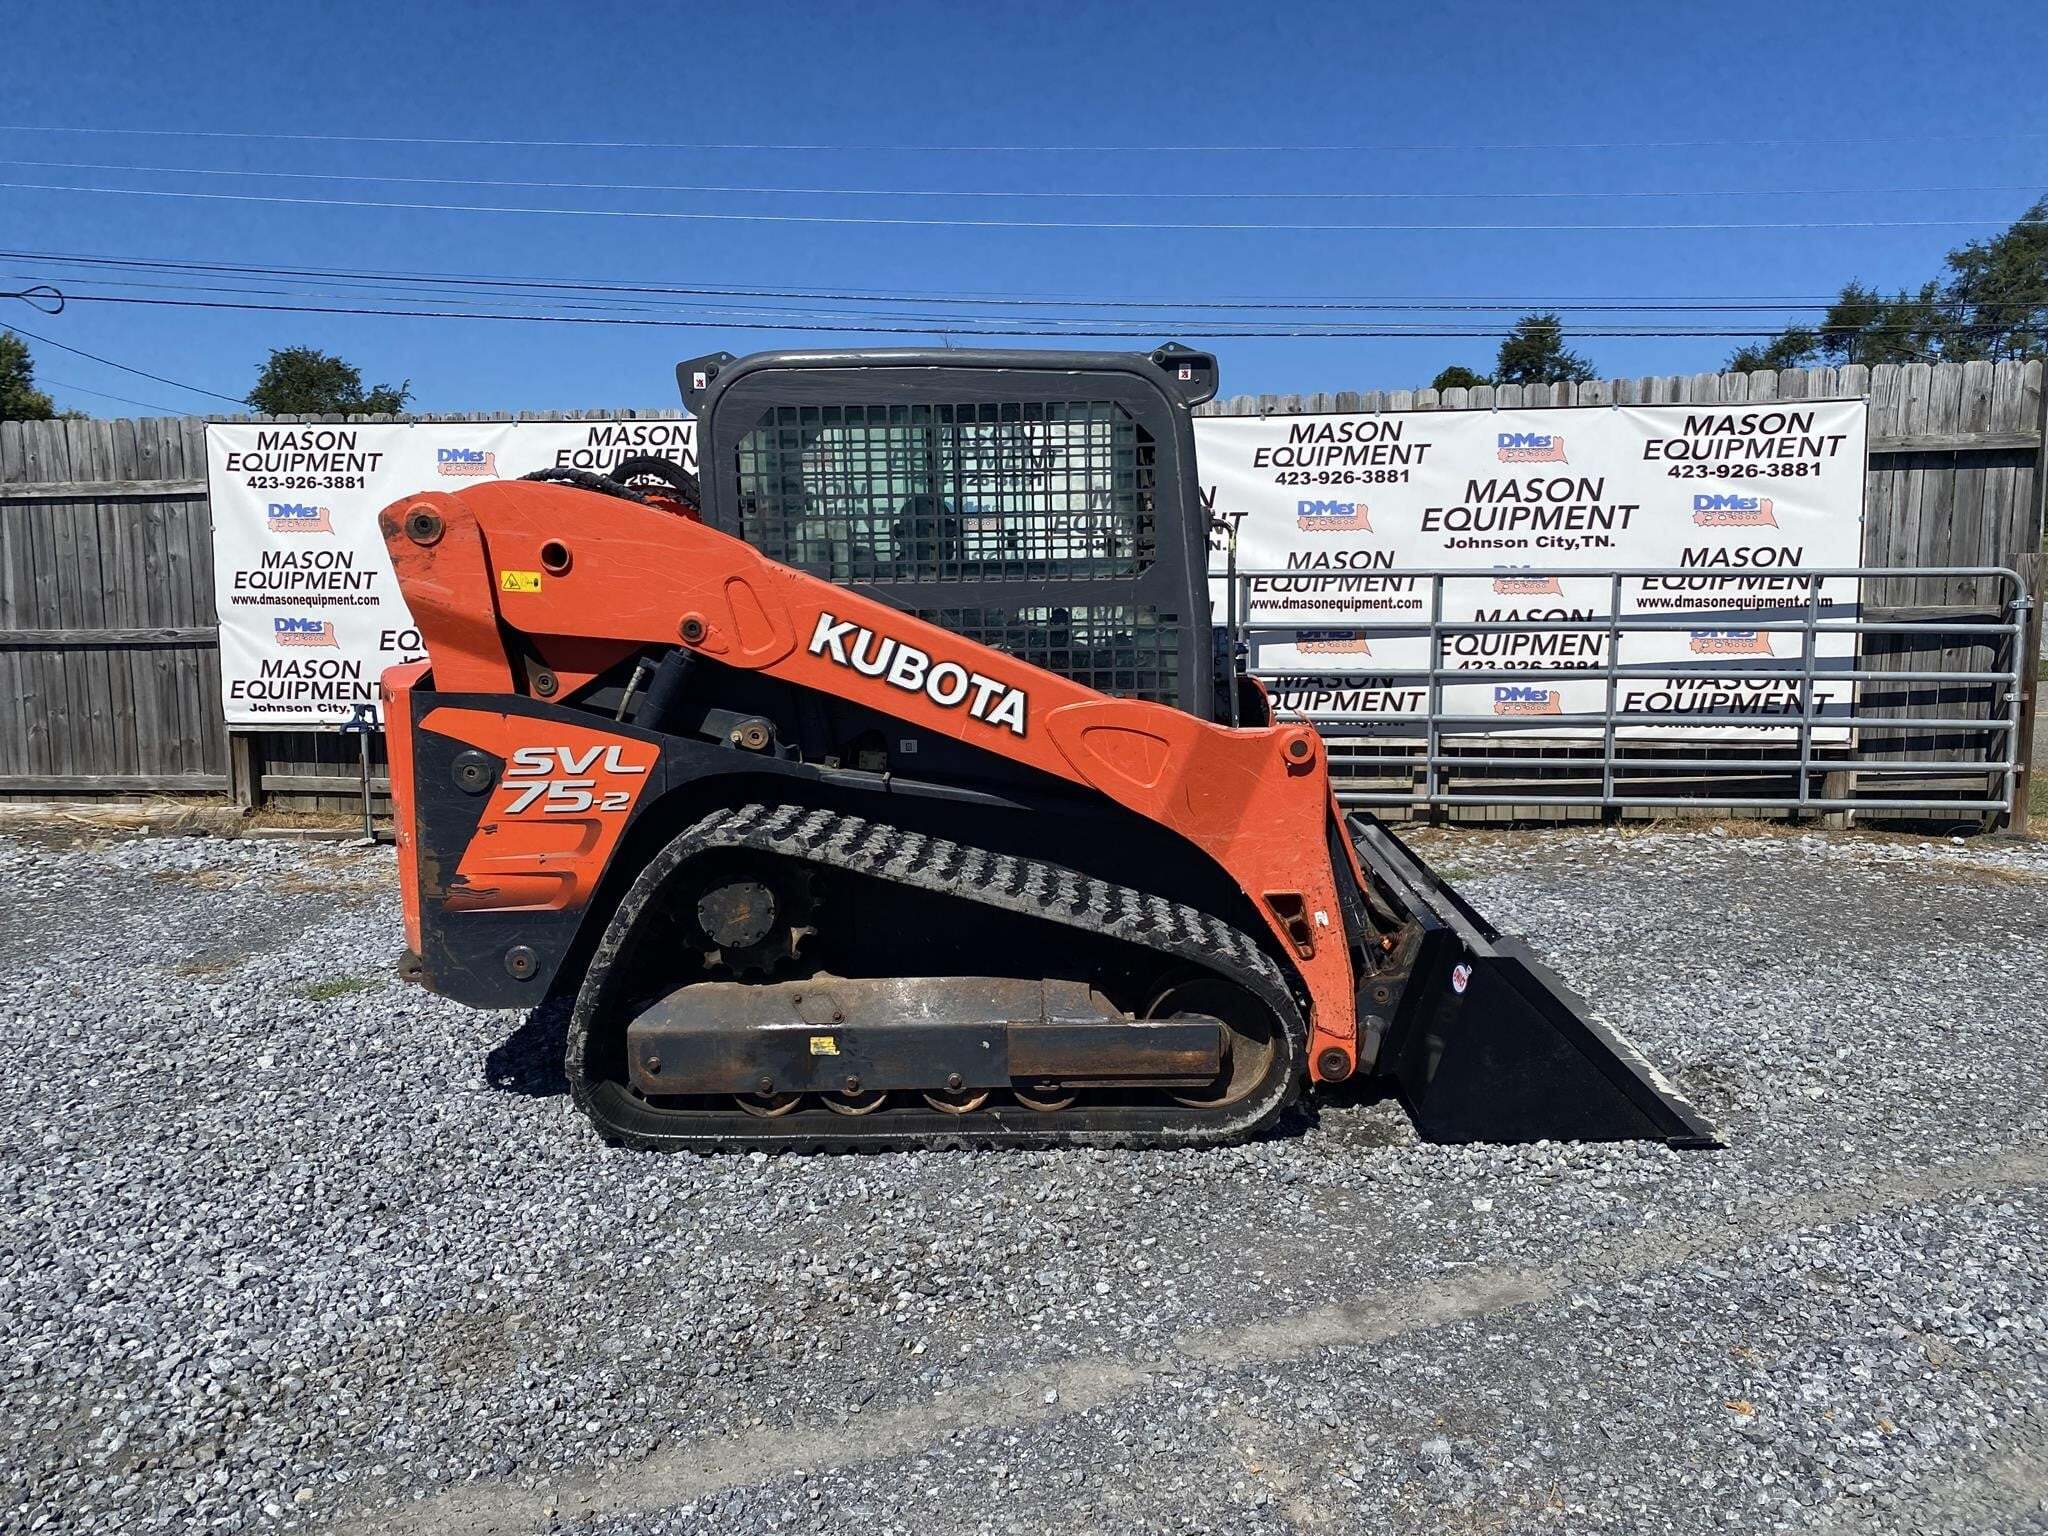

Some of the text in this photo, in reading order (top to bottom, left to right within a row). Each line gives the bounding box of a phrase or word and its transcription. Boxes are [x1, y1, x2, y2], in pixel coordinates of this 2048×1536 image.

[1288, 420, 1404, 444] MASON
[1683, 412, 1815, 436] MASON
[257, 431, 357, 451] MASON
[588, 425, 692, 447] MASON
[1253, 443, 1432, 468] EQUIPMENT
[1642, 434, 1847, 461] EQUIPMENT
[226, 452, 383, 472] EQUIPMENT
[1667, 461, 1821, 479] 423-926-3881
[247, 476, 365, 489] 423-926-3881
[1274, 469, 1411, 486] 423-926-3881
[1464, 477, 1604, 504] MASON
[1421, 505, 1640, 532] EQUIPMENT
[1444, 535, 1616, 550] Johnson City,TN.
[261, 550, 354, 569] MASON
[1287, 550, 1395, 570] MASON
[1679, 547, 1803, 568] MASON
[234, 571, 378, 590] EQUIPMENT
[231, 594, 380, 608] www.dmasonequipment.com
[1249, 596, 1423, 612] www.dmasonequipment.com
[1636, 595, 1834, 611] www.dmasonequipment.cm
[1474, 608, 1594, 623] MASON
[260, 659, 361, 679] MASON
[808, 610, 1026, 736] KUBOTA
[249, 703, 312, 713] Johnson
[1268, 690, 1426, 712] QUIPMENT
[1622, 692, 1835, 715] EQUIPMENT
[507, 745, 646, 776] SVL
[501, 779, 631, 814] 75-2
